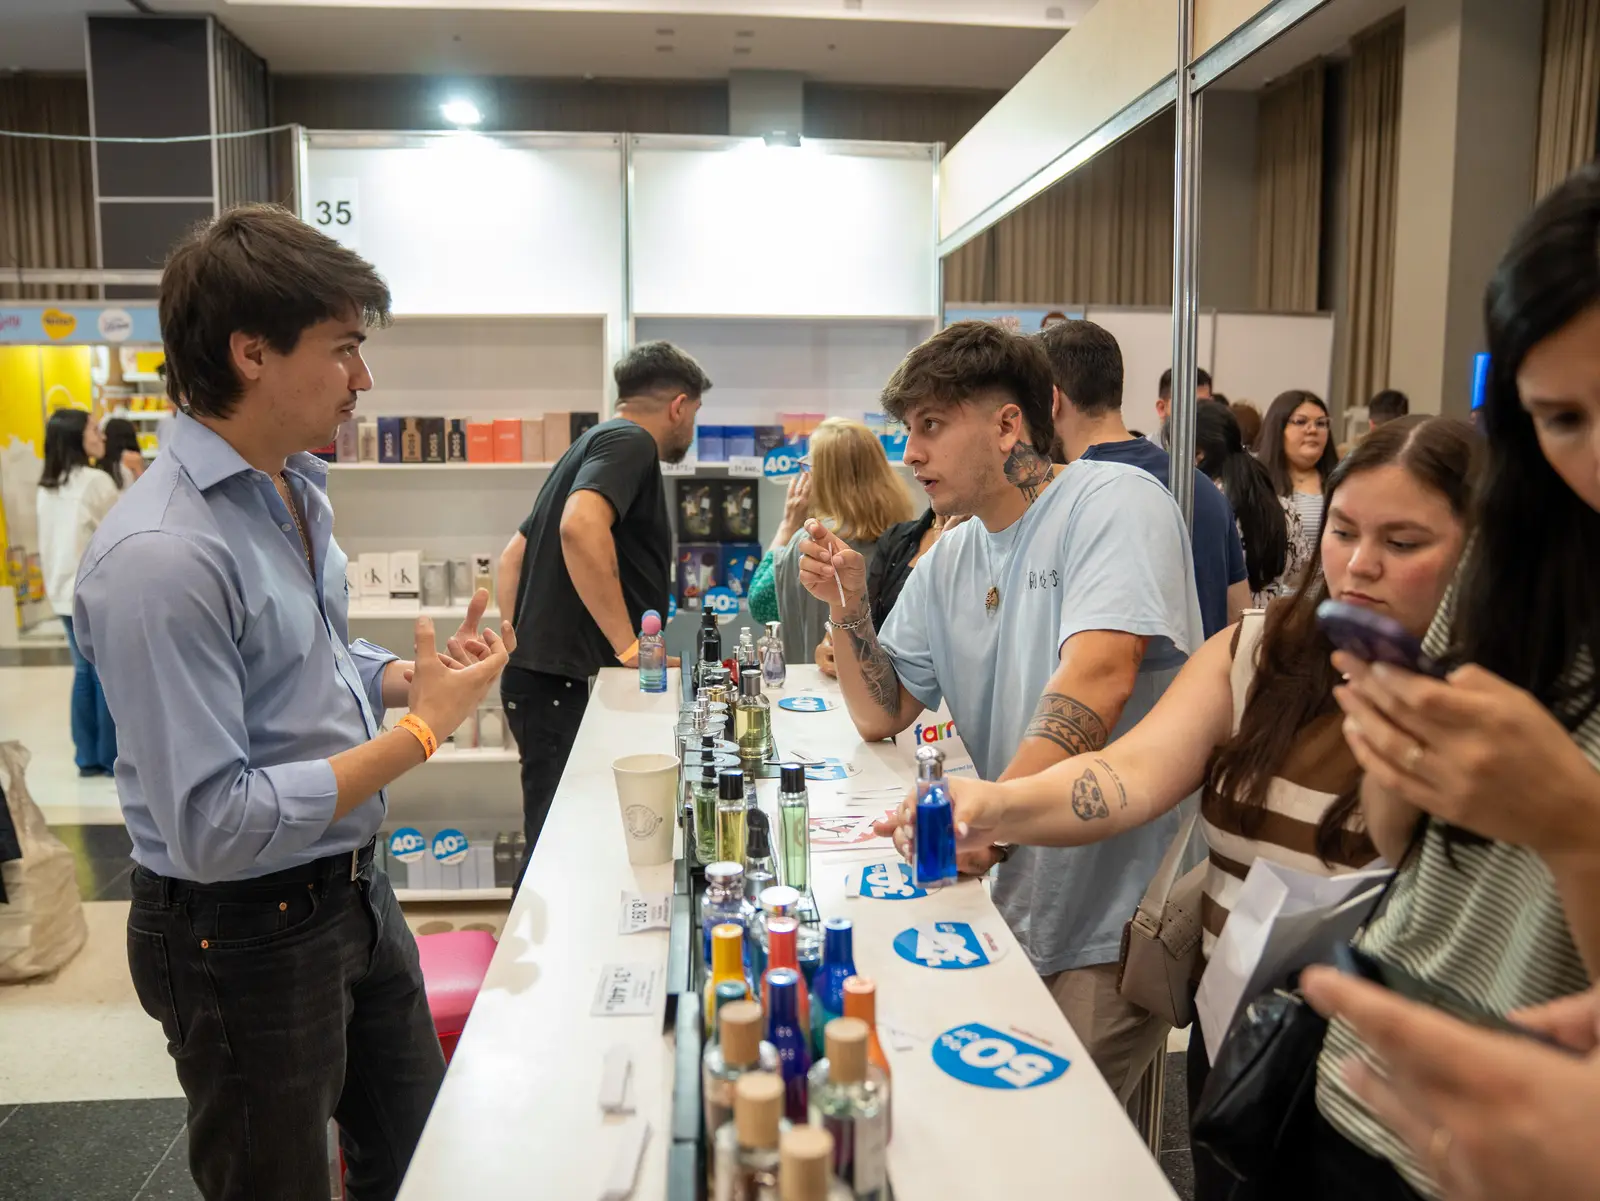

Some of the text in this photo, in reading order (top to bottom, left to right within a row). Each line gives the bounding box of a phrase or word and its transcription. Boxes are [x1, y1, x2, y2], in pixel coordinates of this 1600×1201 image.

[316, 200, 352, 225] 35
[384, 432, 393, 457] BOSS
[407, 433, 416, 456] BOSS
[429, 433, 438, 457] BOSS
[452, 433, 460, 457] BOSS
[959, 1038, 1054, 1087] 50
